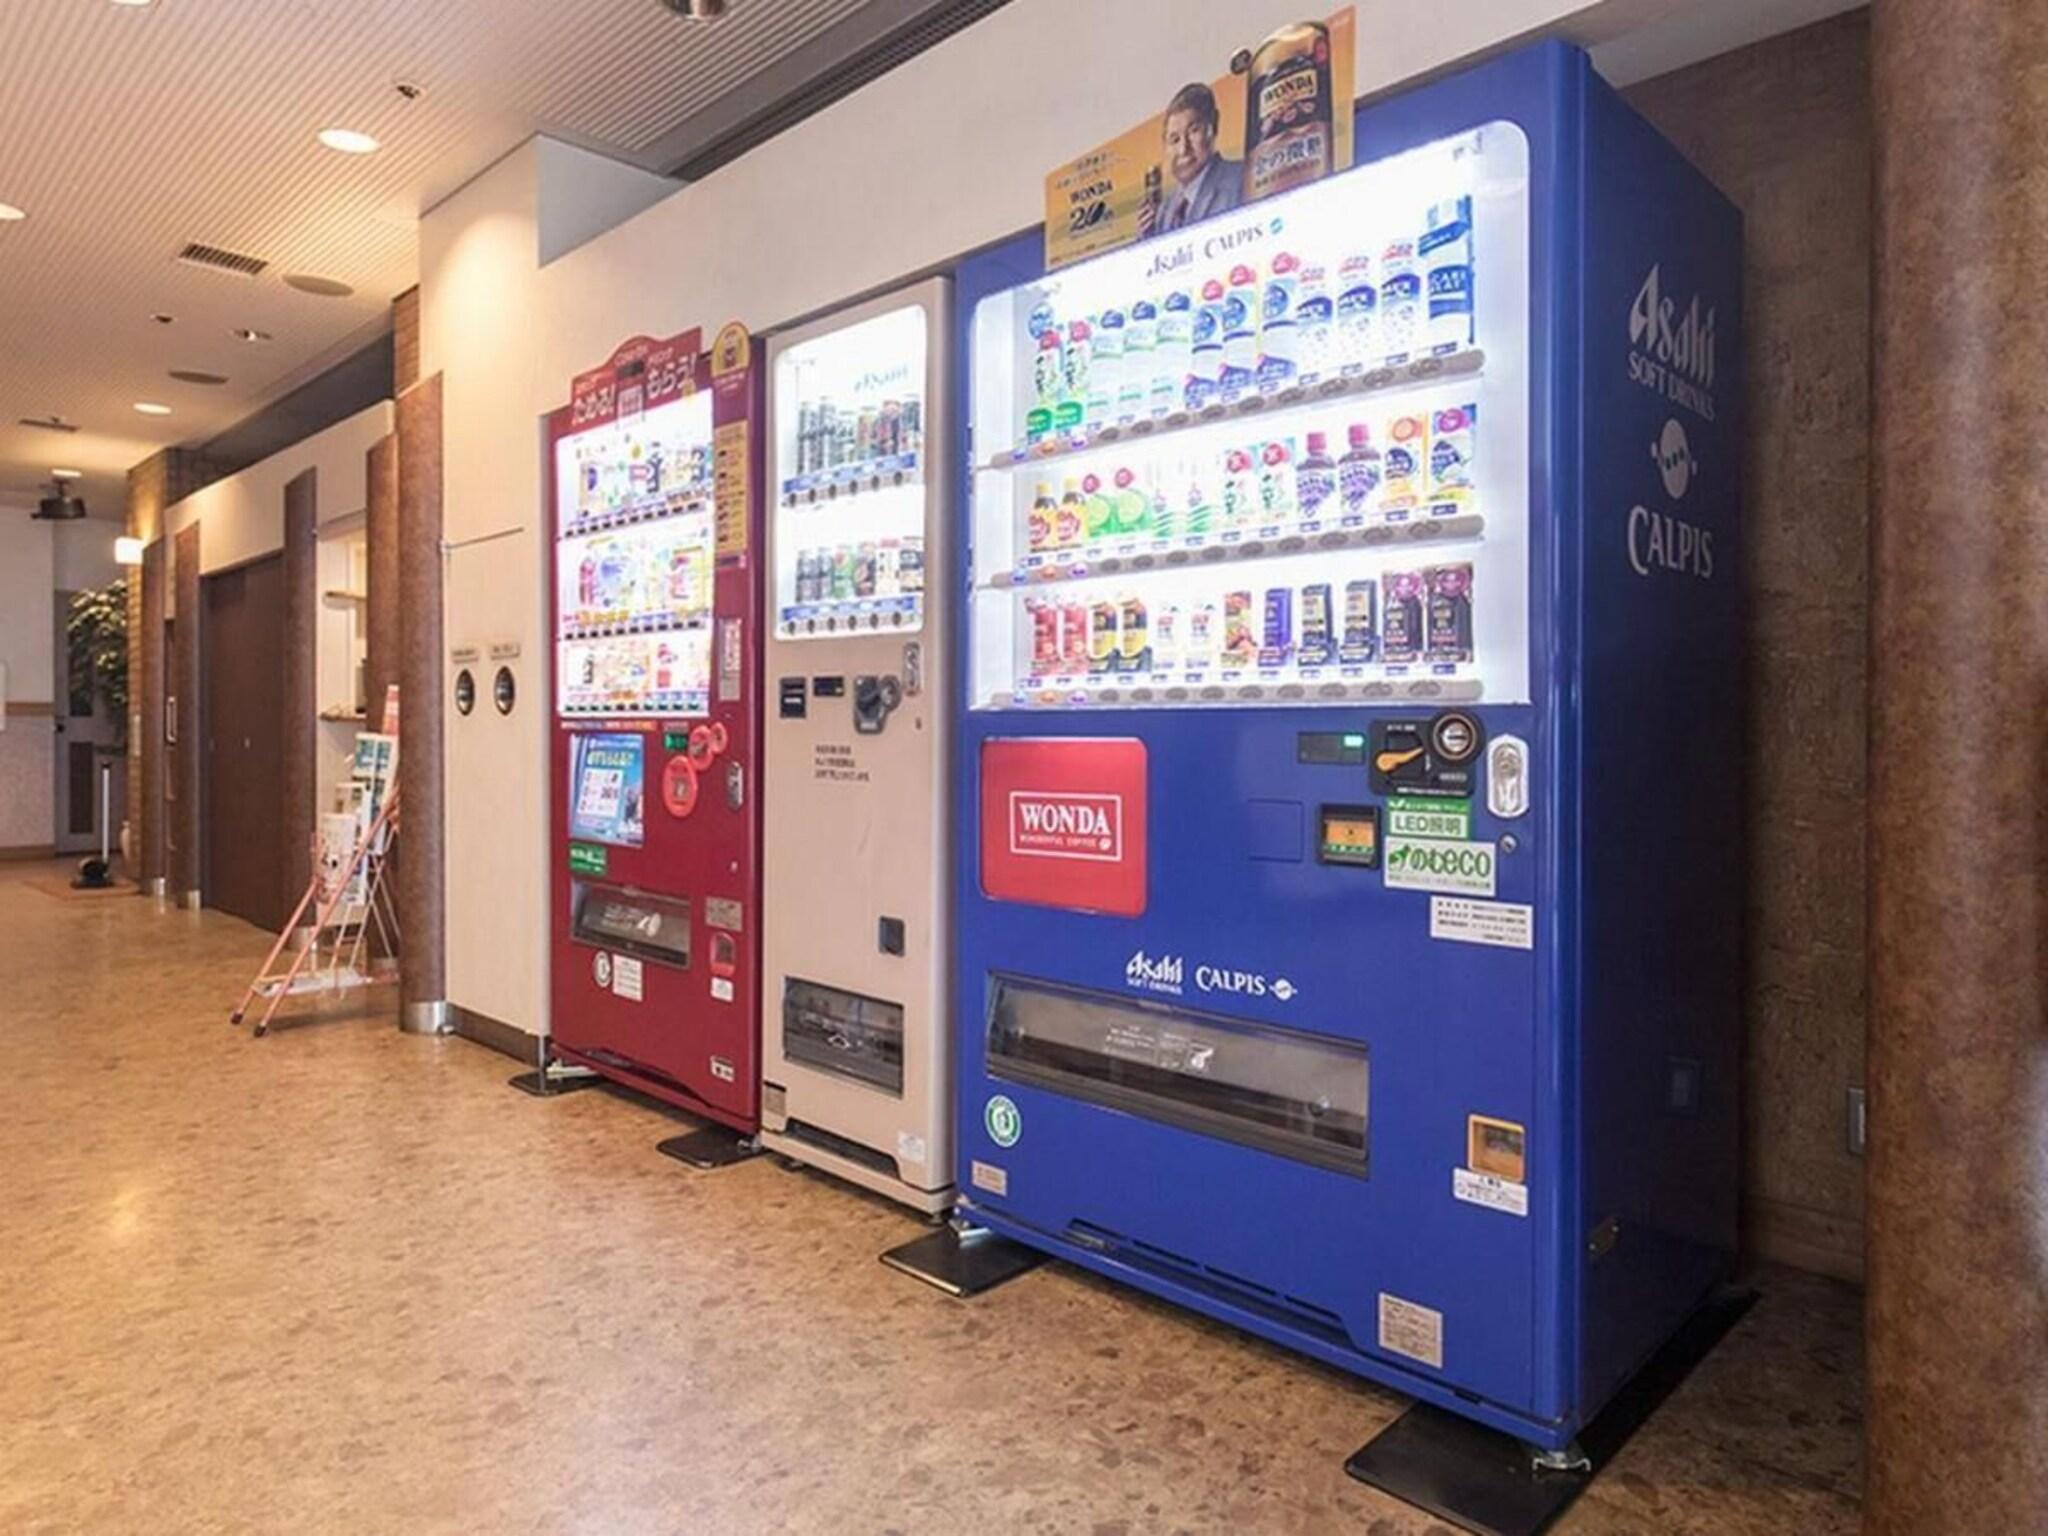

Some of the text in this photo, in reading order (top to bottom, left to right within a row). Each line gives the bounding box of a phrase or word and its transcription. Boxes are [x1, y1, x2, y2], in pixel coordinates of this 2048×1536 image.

[1629, 262, 1716, 389] Asahi
[1628, 350, 1666, 394] SOFT
[1627, 504, 1713, 579] CALPIS
[1018, 802, 1112, 836] WONDA
[1126, 950, 1267, 996] Asahi CALPIS
